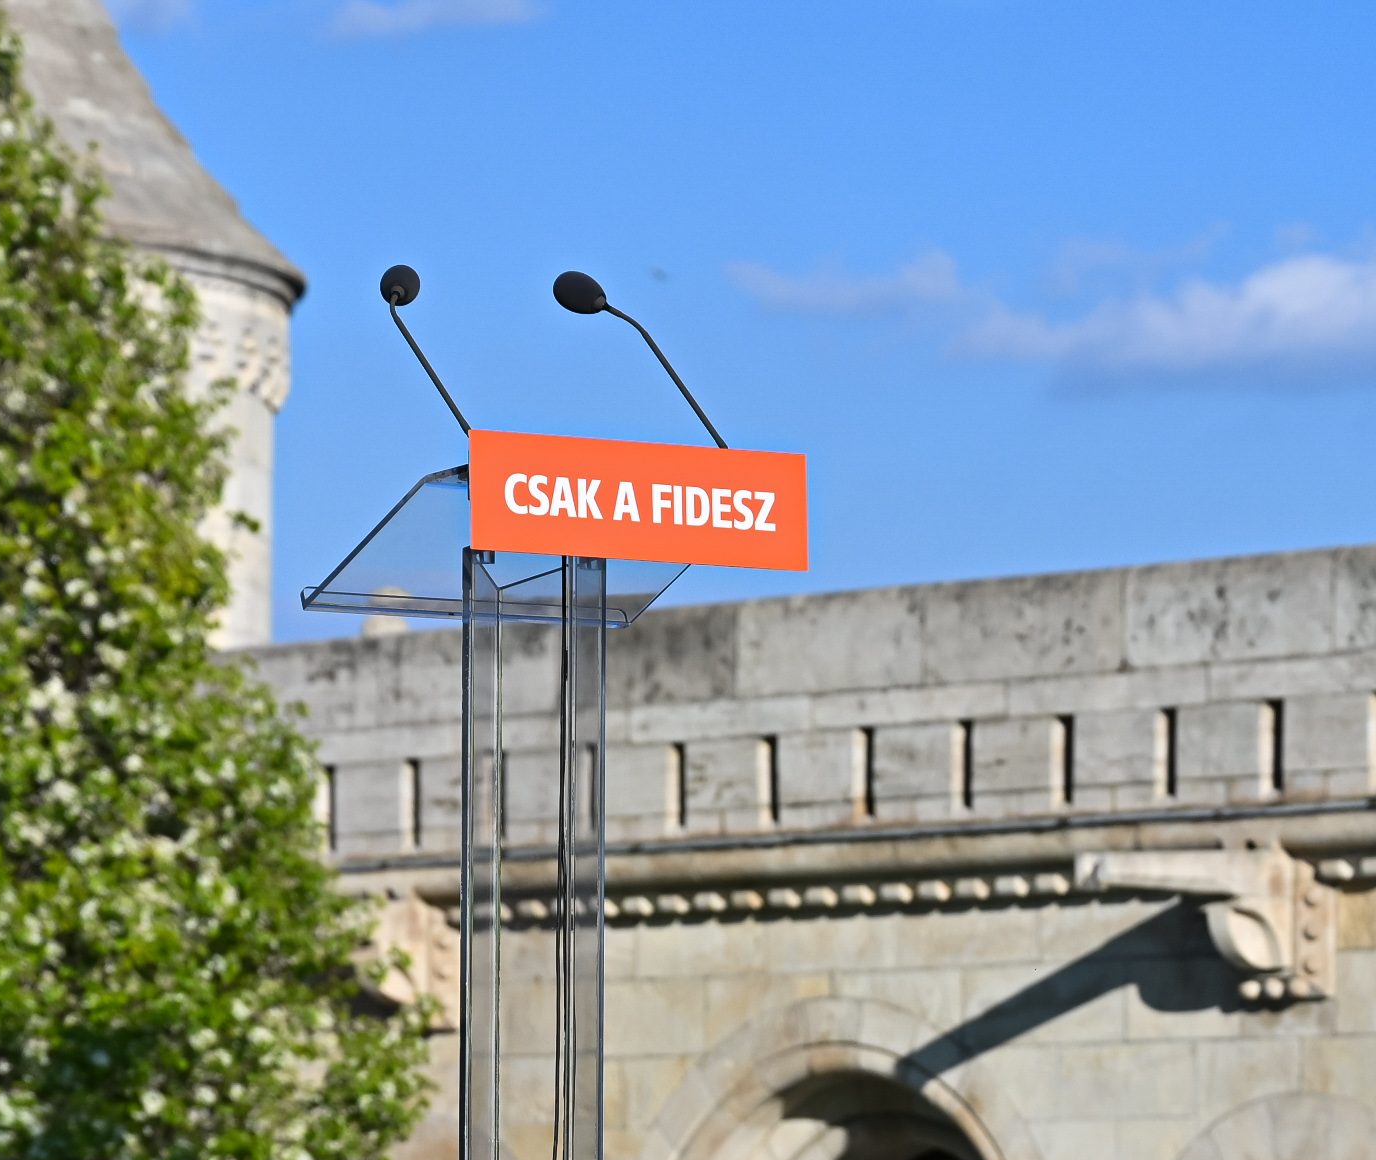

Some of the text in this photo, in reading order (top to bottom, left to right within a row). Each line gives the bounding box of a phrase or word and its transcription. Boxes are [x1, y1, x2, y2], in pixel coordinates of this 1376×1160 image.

[504, 473, 777, 532] CSAK A FIDESZ
